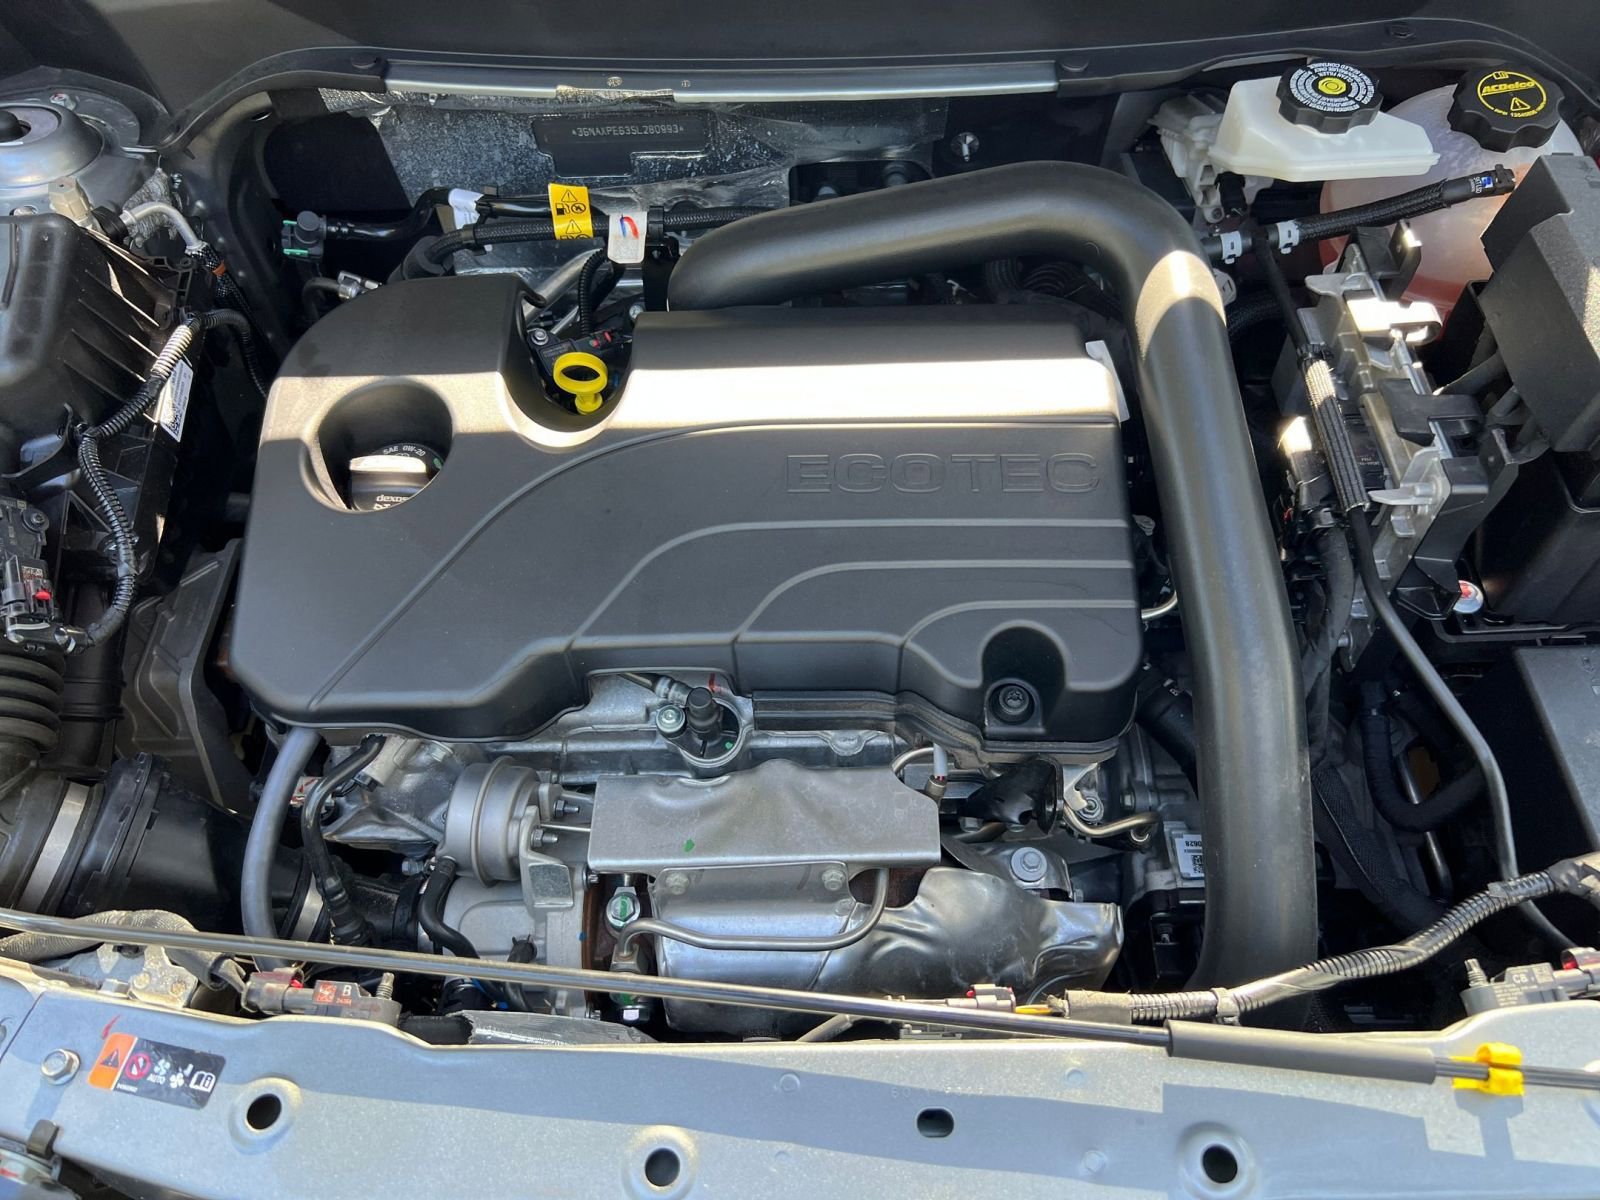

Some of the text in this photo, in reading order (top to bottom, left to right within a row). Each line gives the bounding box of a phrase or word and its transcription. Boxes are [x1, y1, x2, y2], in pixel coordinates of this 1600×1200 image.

[1481, 81, 1535, 93] ACDelco
[383, 445, 426, 457] SAE 0W-20
[786, 452, 1100, 494] ECOTEC
[342, 984, 352, 997] B
[146, 1072, 166, 1085] AUTO
